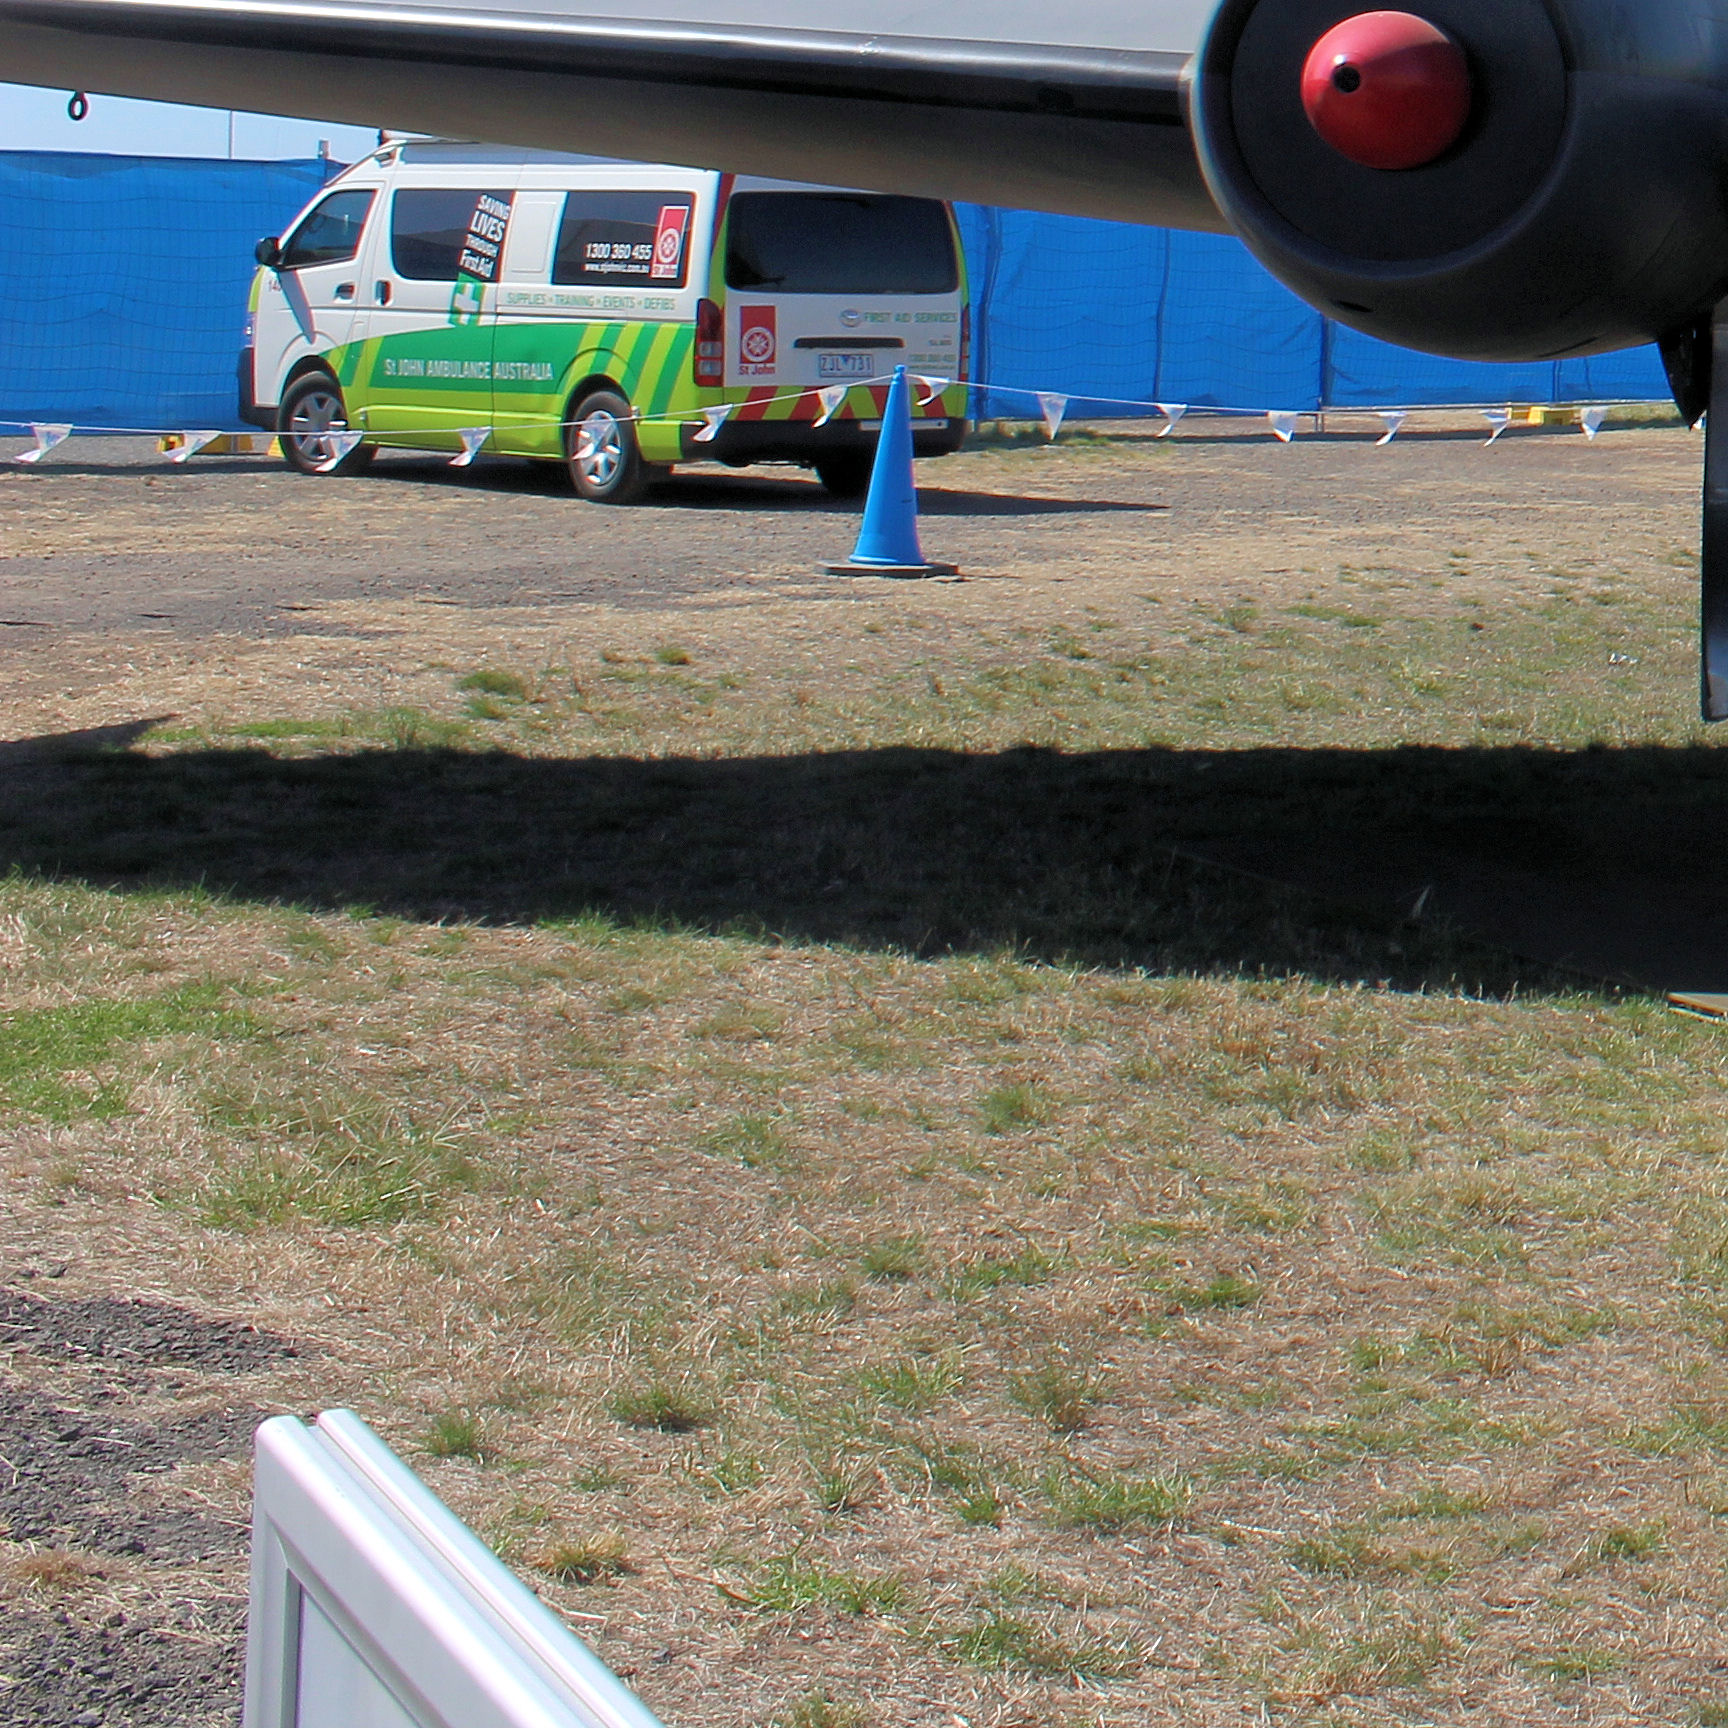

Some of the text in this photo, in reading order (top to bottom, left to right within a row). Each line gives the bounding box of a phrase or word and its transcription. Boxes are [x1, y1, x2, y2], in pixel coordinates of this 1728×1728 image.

[477, 194, 511, 220] SAVING
[470, 210, 506, 243] LIVES
[465, 234, 499, 258] THROUGH
[585, 242, 653, 260] 1300 360 455
[460, 248, 494, 278] First Aid
[505, 292, 676, 310] SUPPLIES TRAINING EVENTS DEFIBS
[863, 311, 959, 323] FIRST AID SERVICES
[385, 358, 554, 381] St JOHN AMBULANCE AUSTRALIA
[738, 363, 776, 375] St John
[822, 356, 871, 372] ZJL 731
